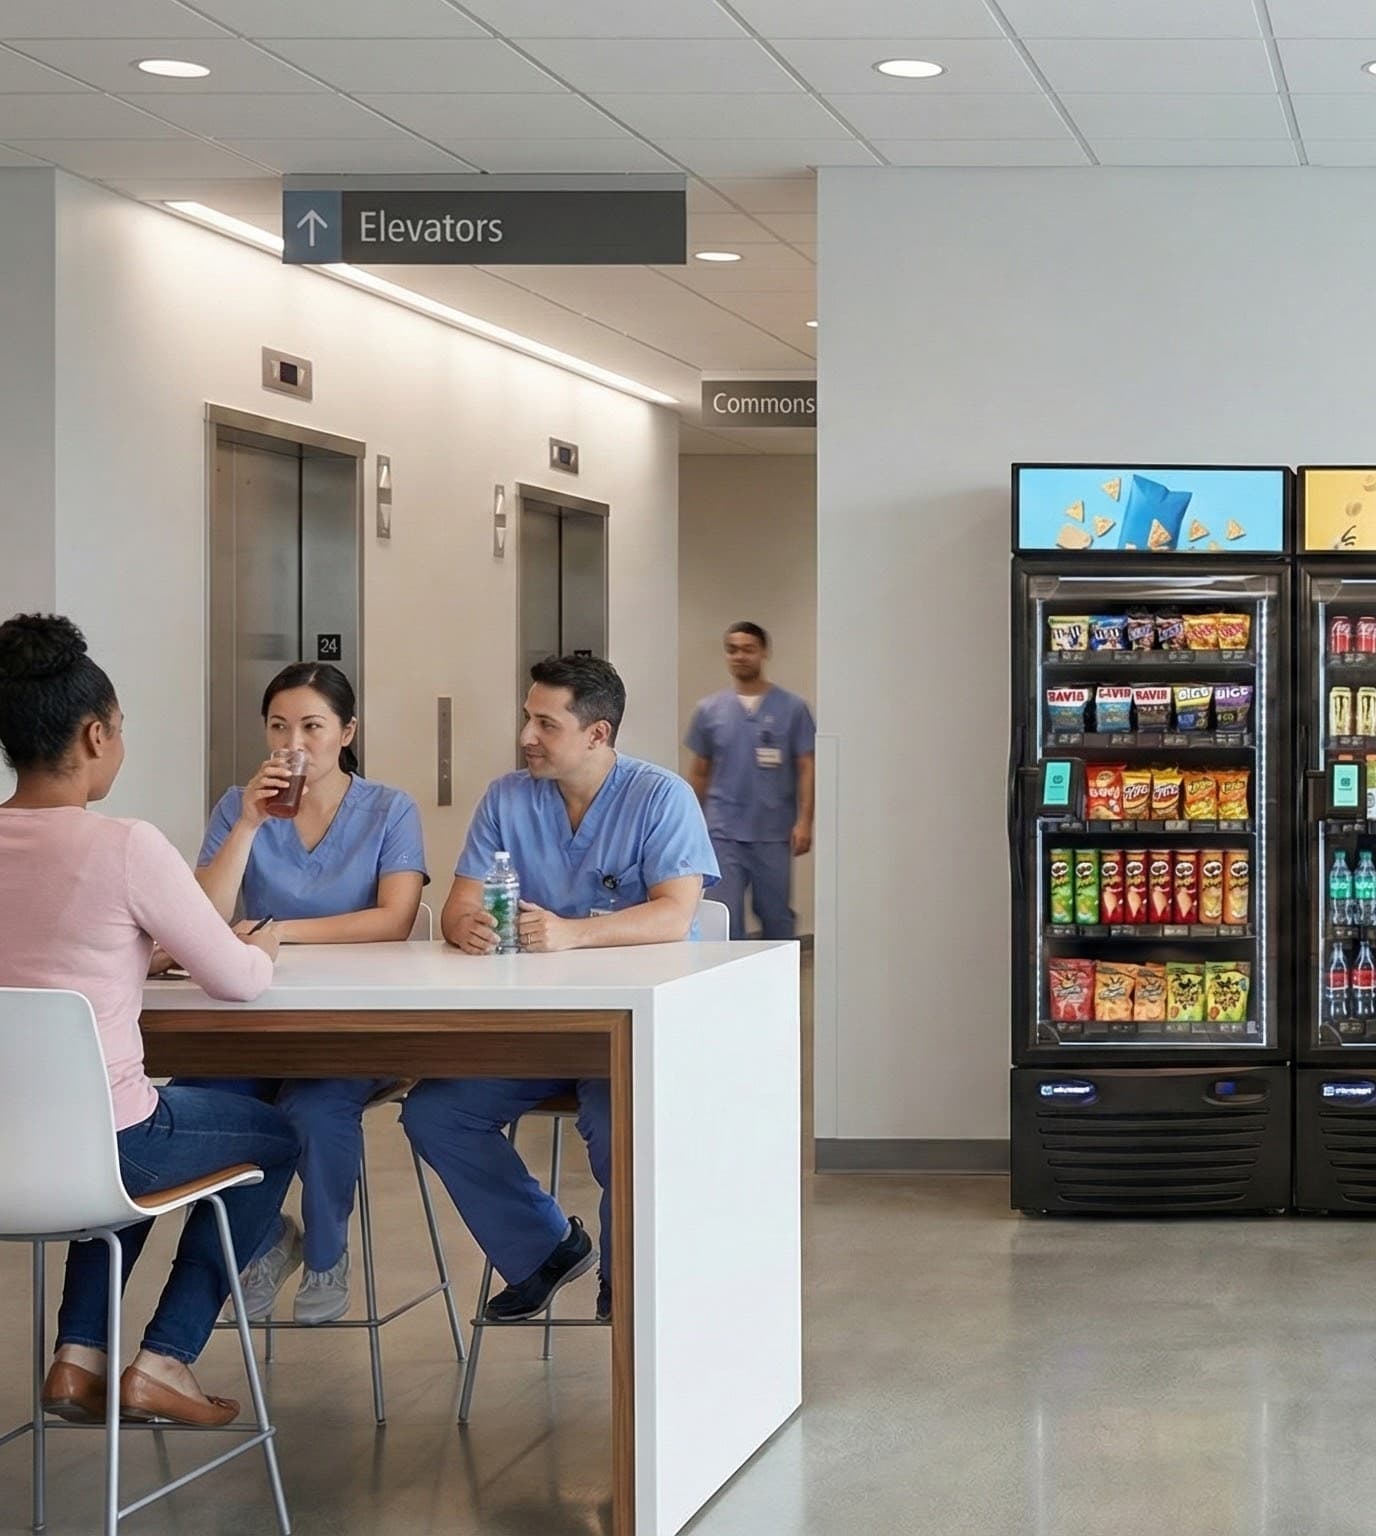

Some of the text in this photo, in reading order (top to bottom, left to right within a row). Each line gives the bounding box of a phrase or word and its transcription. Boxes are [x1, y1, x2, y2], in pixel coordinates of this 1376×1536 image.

[360, 210, 503, 243] Elevators
[713, 393, 816, 414] Commons
[320, 638, 338, 653] 24
